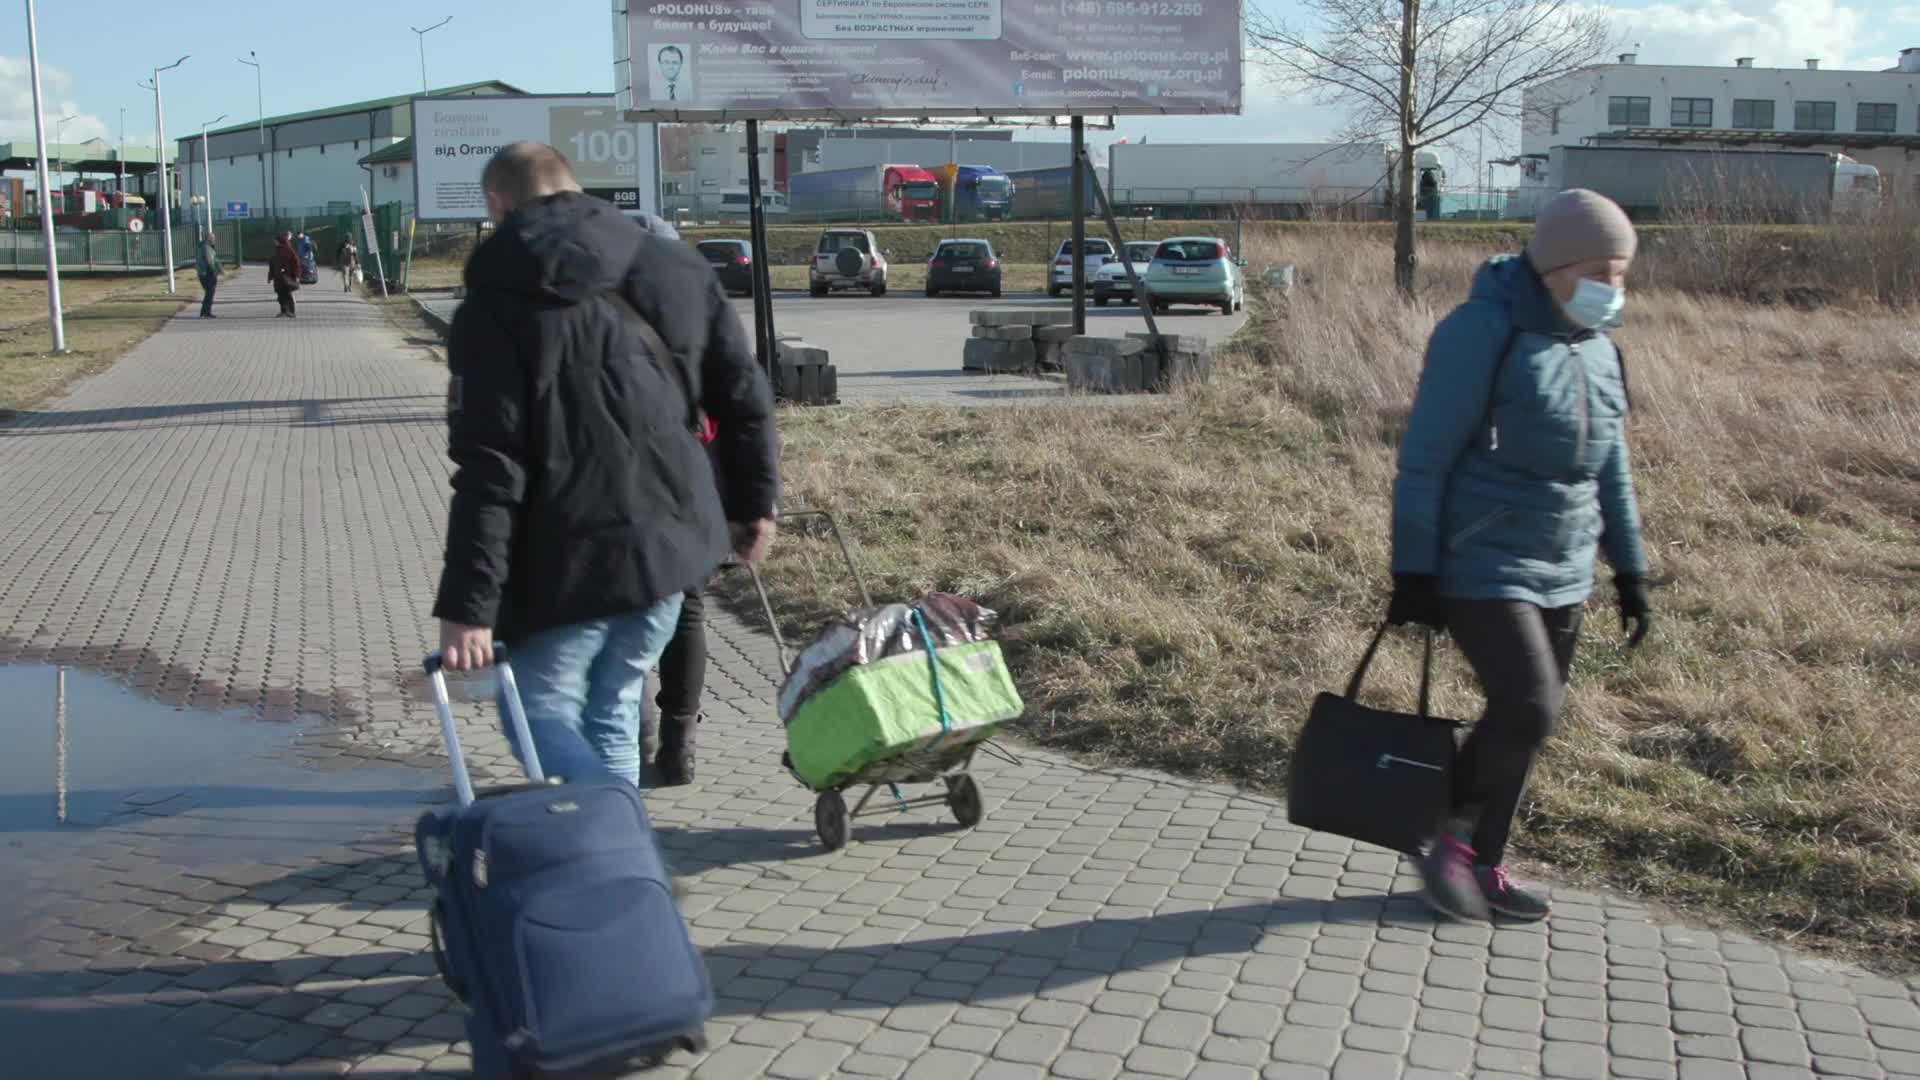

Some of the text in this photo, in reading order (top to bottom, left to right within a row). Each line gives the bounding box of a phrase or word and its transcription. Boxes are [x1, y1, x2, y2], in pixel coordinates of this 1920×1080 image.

[649, 3, 732, 15] «POLONUS»
[709, 18, 772, 32] будущее!
[854, 24, 914, 32] ВОЗРАСТНЫХ
[435, 143, 456, 157] від
[569, 129, 636, 163] 100
